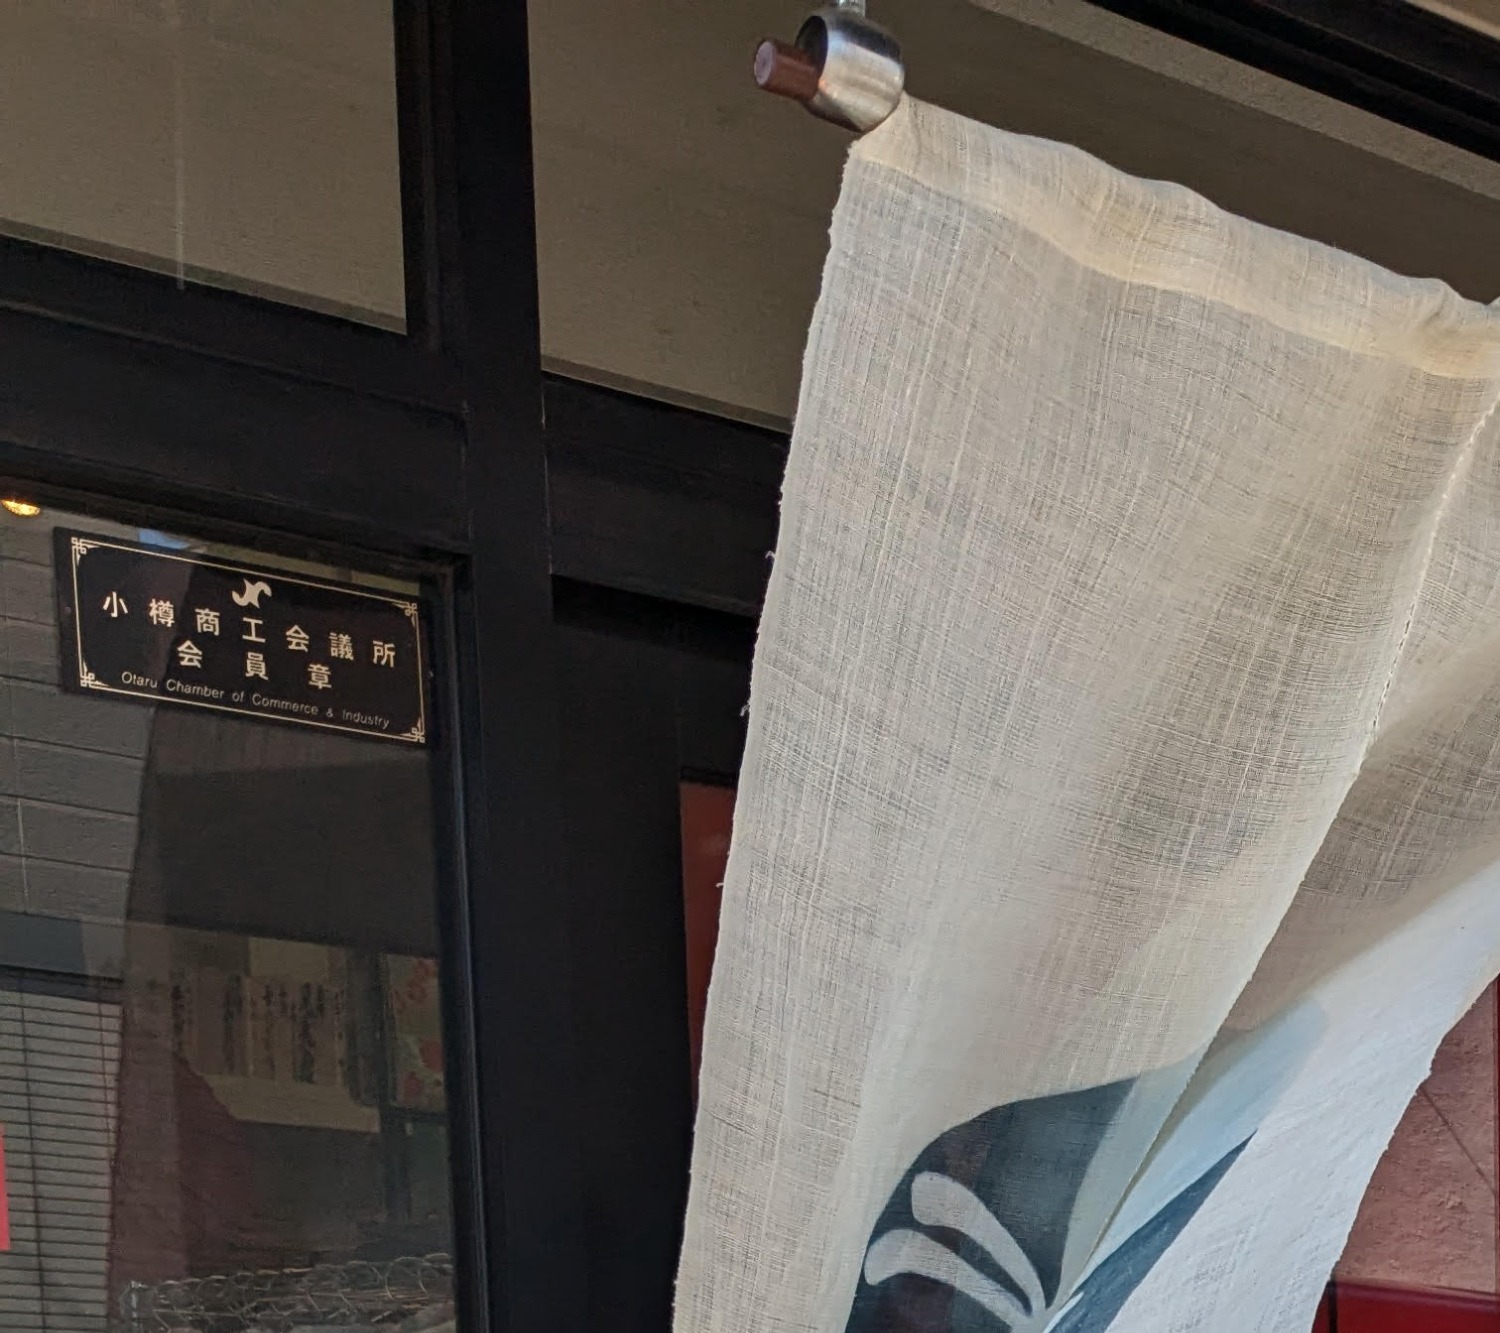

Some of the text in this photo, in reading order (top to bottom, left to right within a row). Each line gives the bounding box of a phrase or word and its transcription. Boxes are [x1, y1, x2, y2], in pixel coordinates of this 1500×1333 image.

[102, 591, 397, 668] 小樽商工会議所
[176, 639, 333, 690] 会員章
[121, 671, 390, 730] Otaru Chamber of Commerce & Industry
